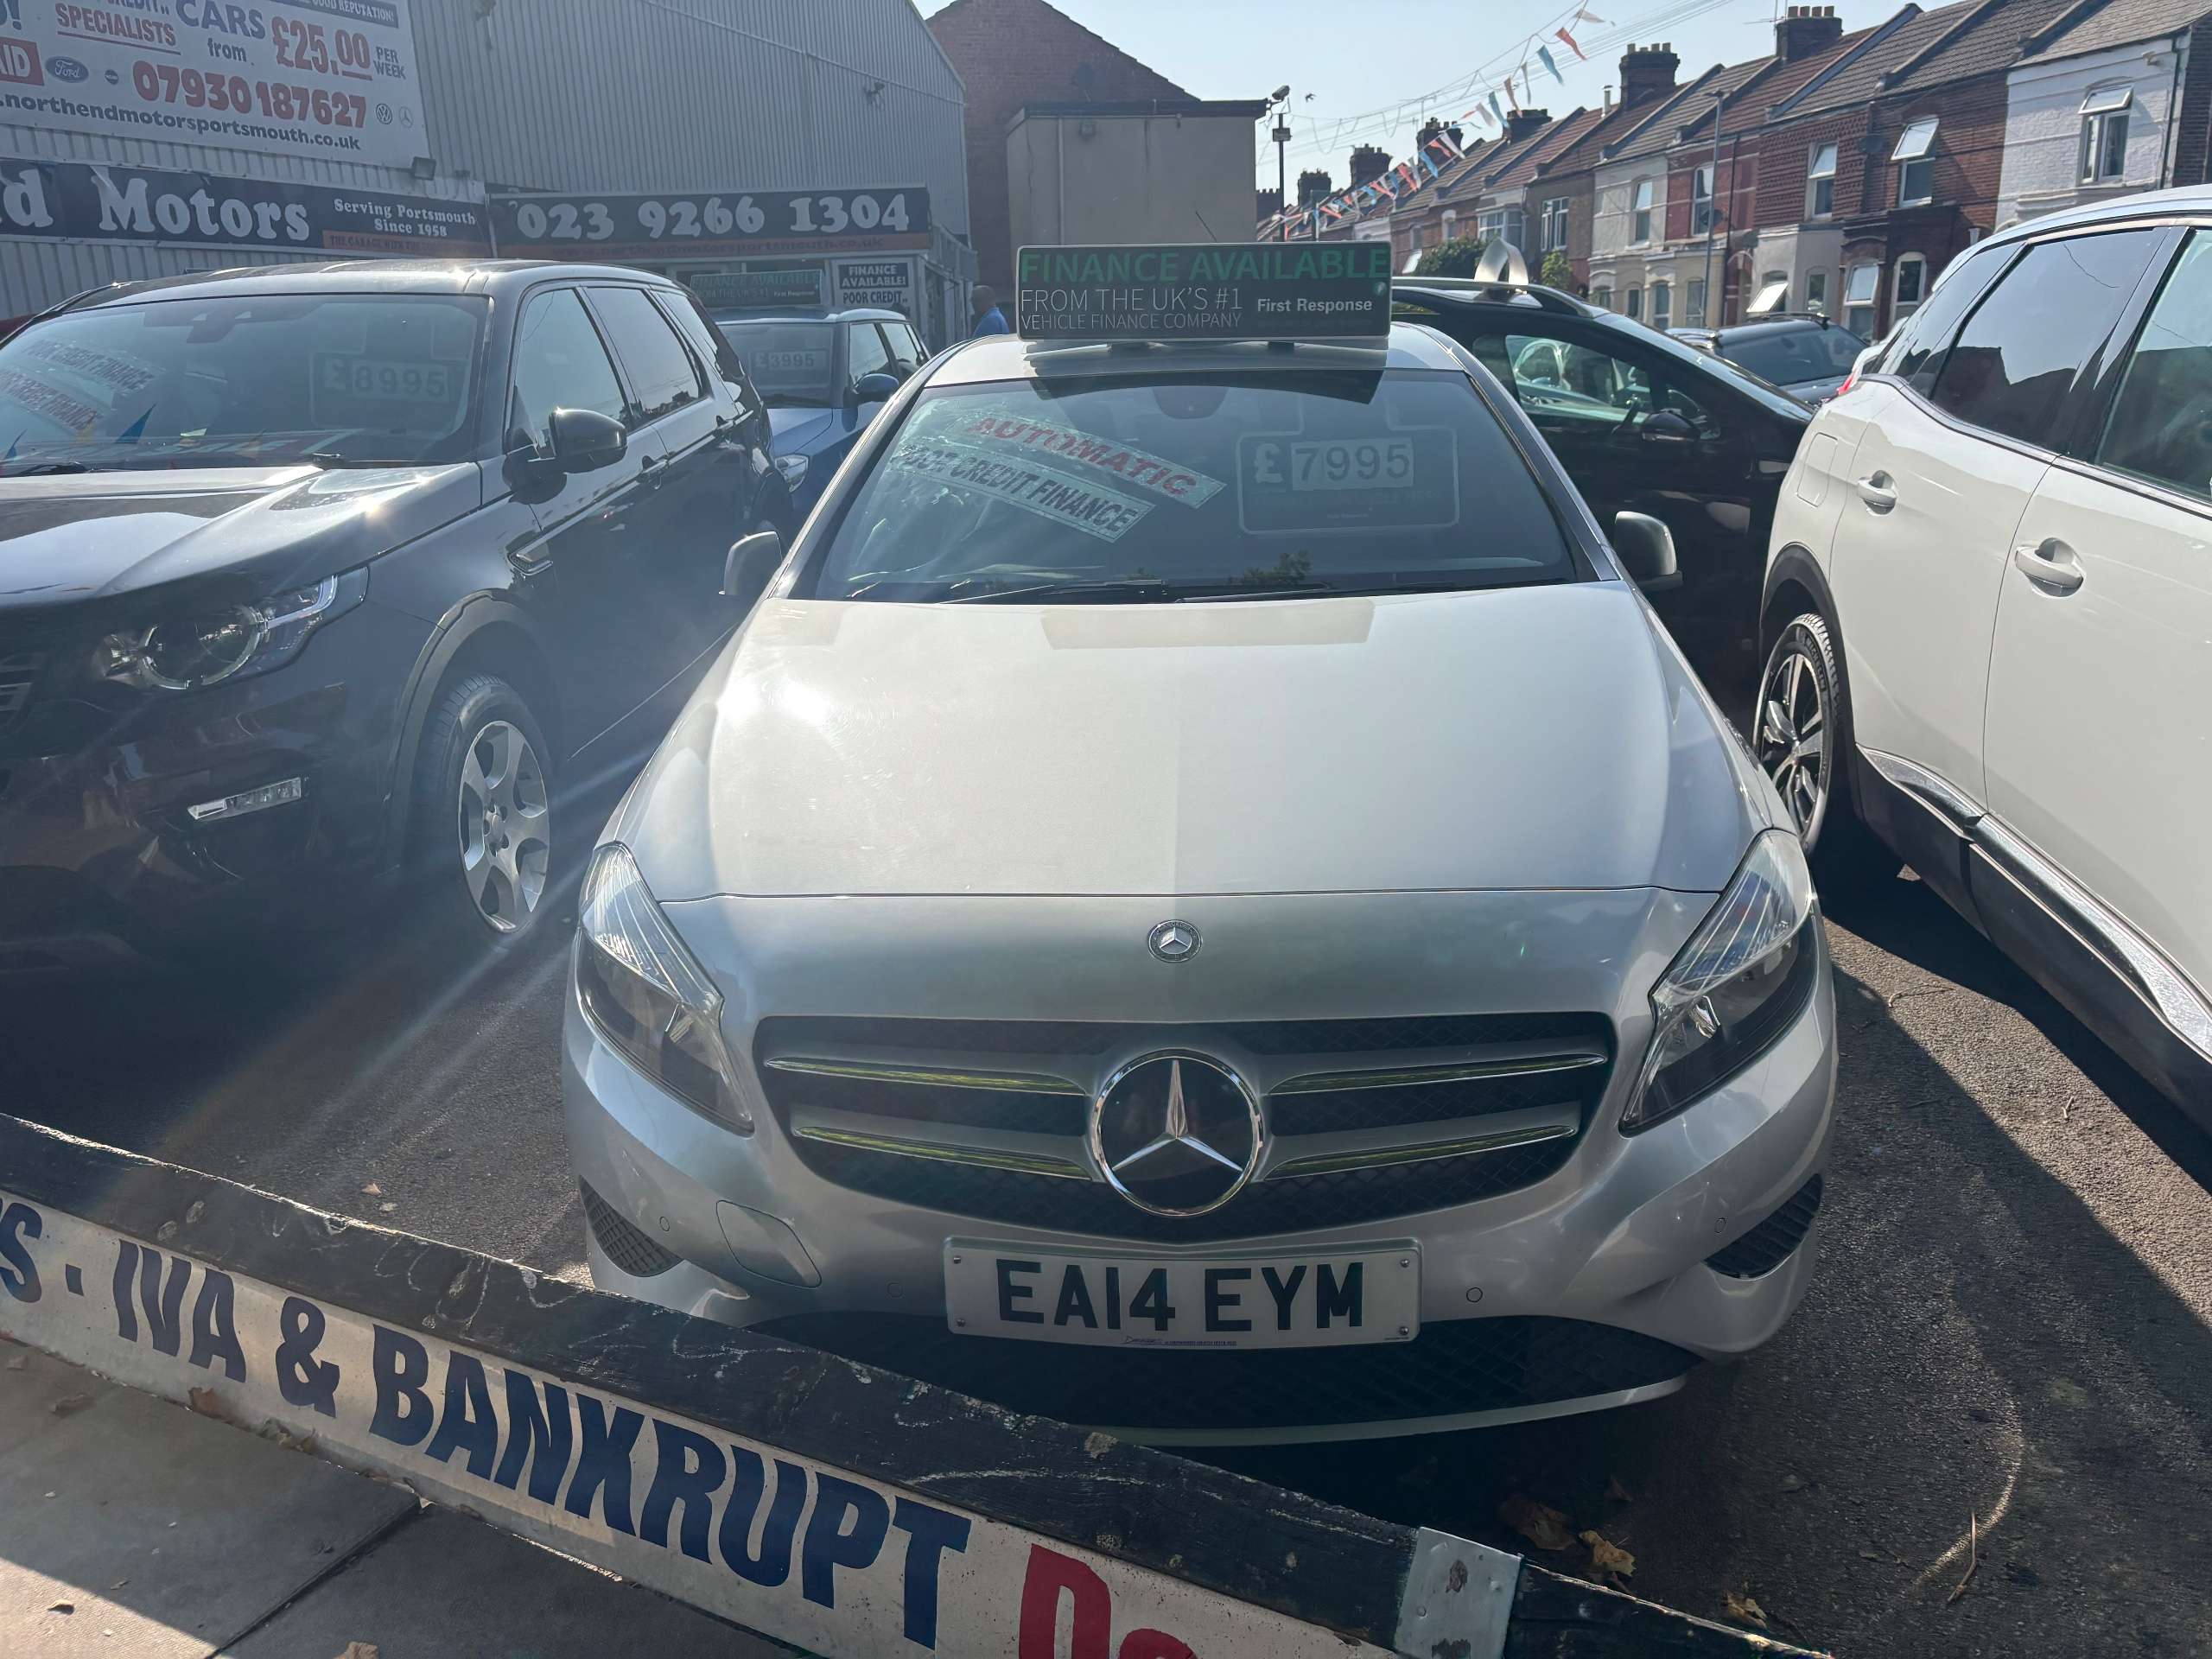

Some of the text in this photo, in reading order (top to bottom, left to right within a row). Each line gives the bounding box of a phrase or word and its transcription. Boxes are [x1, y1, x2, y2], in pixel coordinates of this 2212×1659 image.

[54, 3, 176, 47] SPECIALISTS
[176, 0, 265, 39] CARS
[207, 37, 247, 62] from
[271, 16, 371, 76] £25.00
[375, 46, 399, 63] PER
[54, 60, 79, 78] Ford
[373, 60, 407, 79] WEEK
[91, 175, 310, 241] Motors
[334, 199, 476, 225] Serving Portsmouth
[518, 194, 910, 240] 023 9266 1304
[374, 218, 412, 233] Since
[849, 264, 898, 276] FINANCE
[1020, 247, 1388, 283] FINANCE AVAILABLE
[842, 276, 906, 288] AVAILABLE!
[843, 291, 869, 304] POOR
[1020, 288, 1088, 313] FROM
[1096, 288, 1144, 312] THE
[1215, 287, 1245, 311] #1
[1257, 297, 1373, 315] First Response
[1020, 314, 1086, 331] VEHICLE
[1091, 314, 1162, 331] FINANCE
[1163, 313, 1242, 330] COMPANY
[968, 416, 1196, 497] AUTOMATIC
[950, 456, 1040, 494] CREDIT
[1027, 478, 1141, 533] FINANCE
[995, 1257, 1365, 1333] EA14 EYM
[112, 1238, 247, 1383] IVA
[276, 1296, 340, 1418] &
[369, 1324, 971, 1651] BANKRUPT
